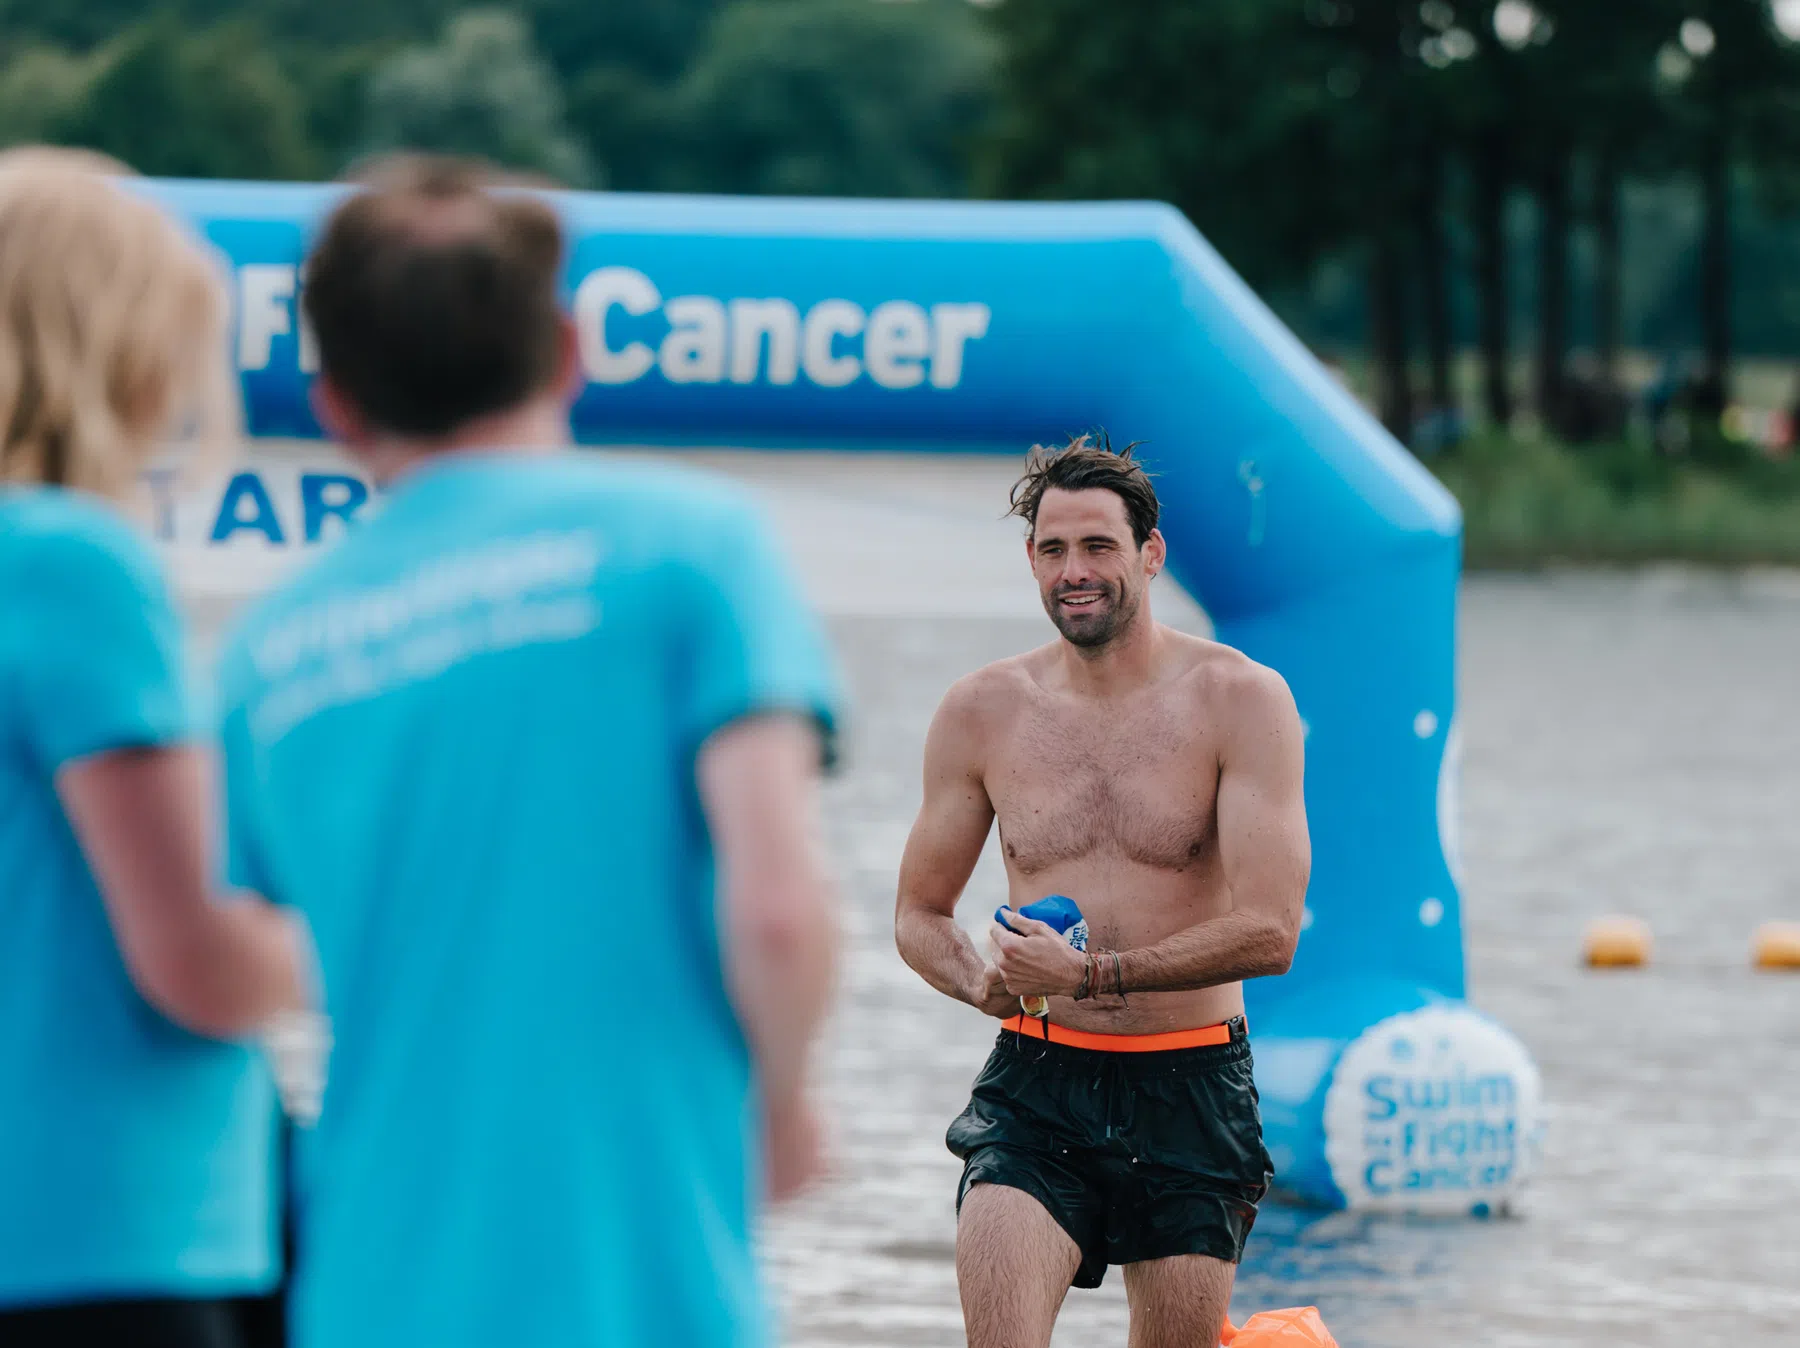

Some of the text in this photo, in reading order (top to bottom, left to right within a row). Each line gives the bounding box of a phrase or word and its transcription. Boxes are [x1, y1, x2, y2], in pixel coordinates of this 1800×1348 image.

[573, 266, 990, 390] Cancer
[138, 470, 369, 545] TAR
[1364, 1064, 1514, 1121] Swim
[1364, 1160, 1509, 1194] Cancer
